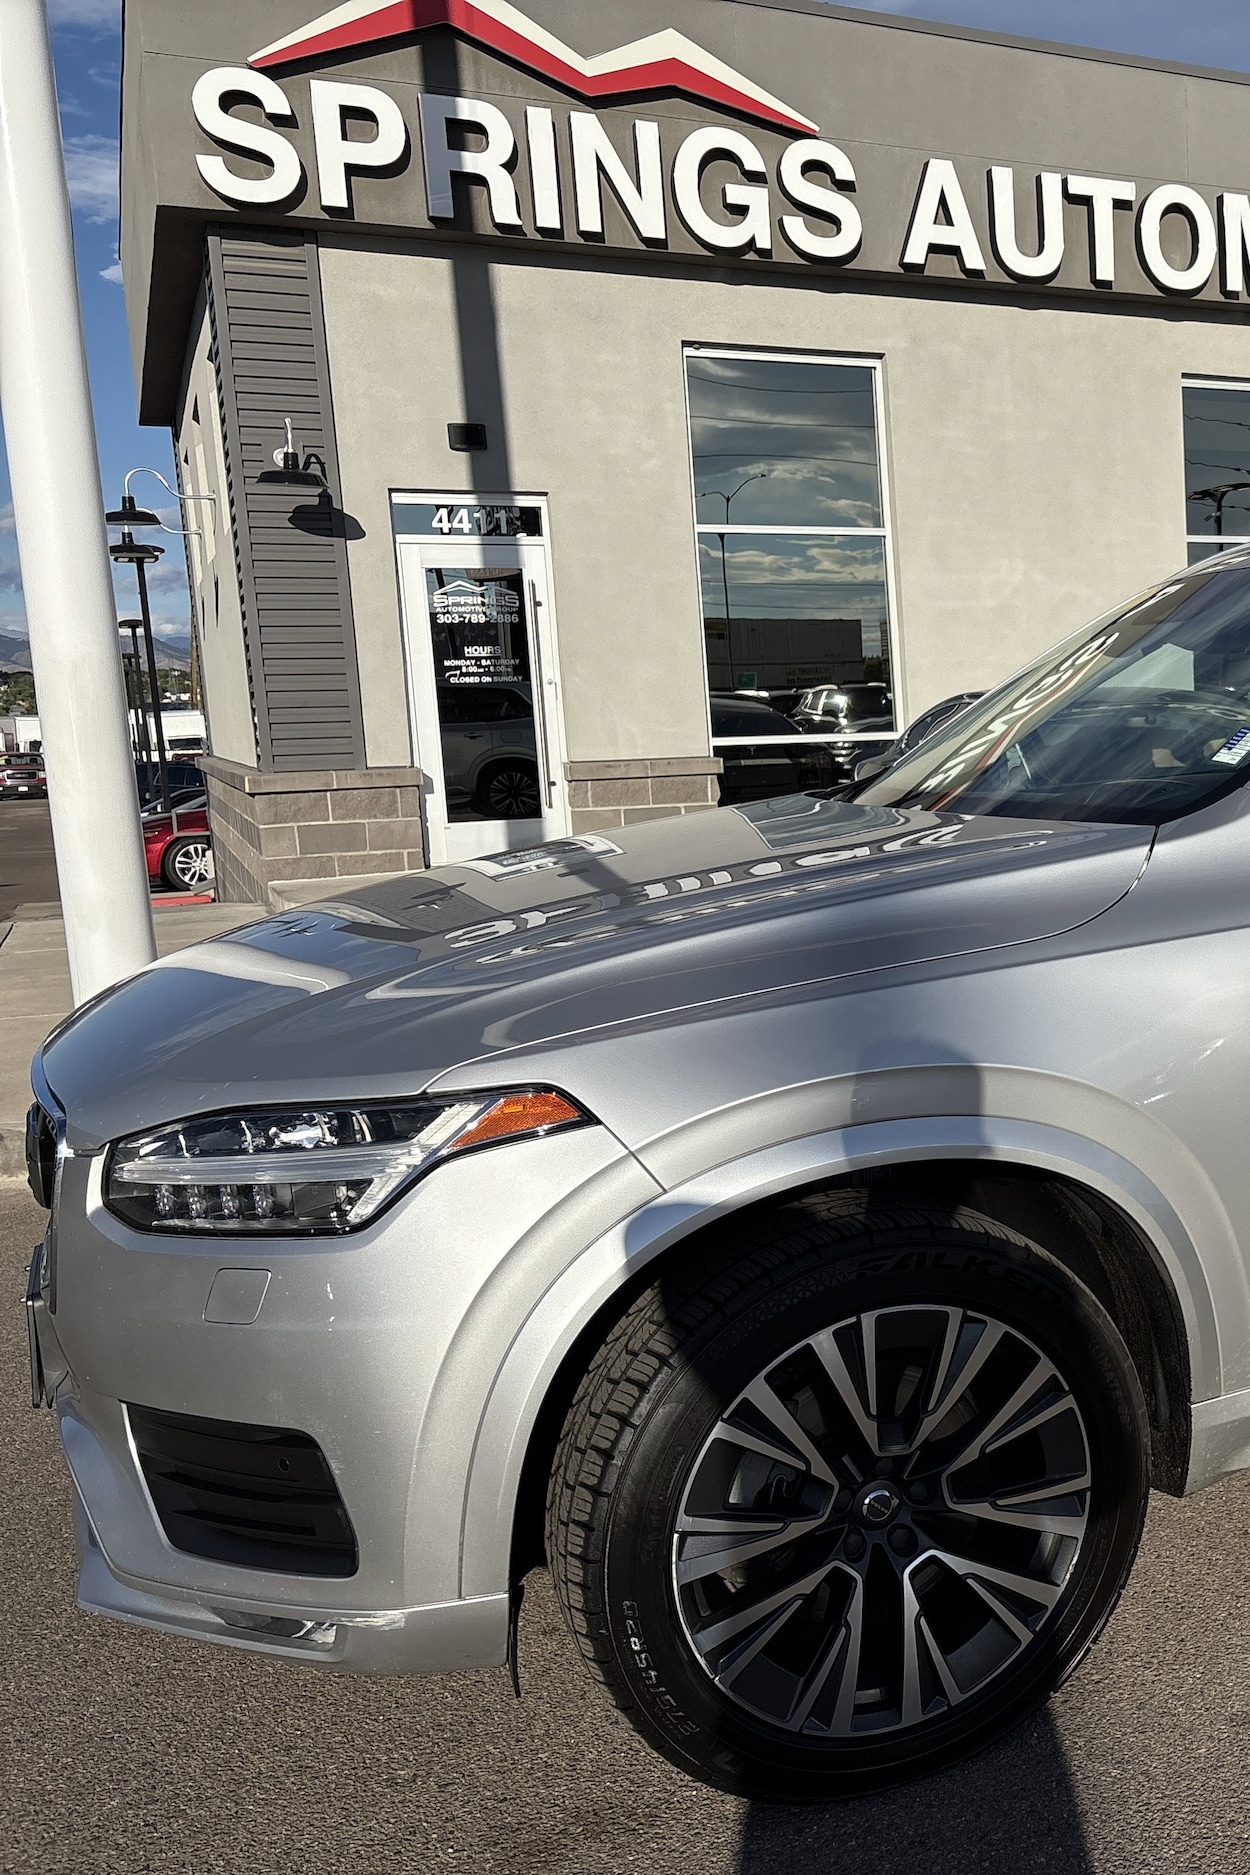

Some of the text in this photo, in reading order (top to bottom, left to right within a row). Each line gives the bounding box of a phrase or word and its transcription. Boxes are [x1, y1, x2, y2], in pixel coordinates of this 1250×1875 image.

[192, 65, 862, 258] SPRINGS
[431, 507, 508, 534] 4411
[433, 595, 519, 607] SPRINGS
[436, 613, 519, 624] 303-789-2886
[464, 645, 502, 655] HOURS
[443, 659, 476, 667] MONDAY
[450, 676, 480, 684] CLOSED
[493, 675, 523, 683] SUNDAY
